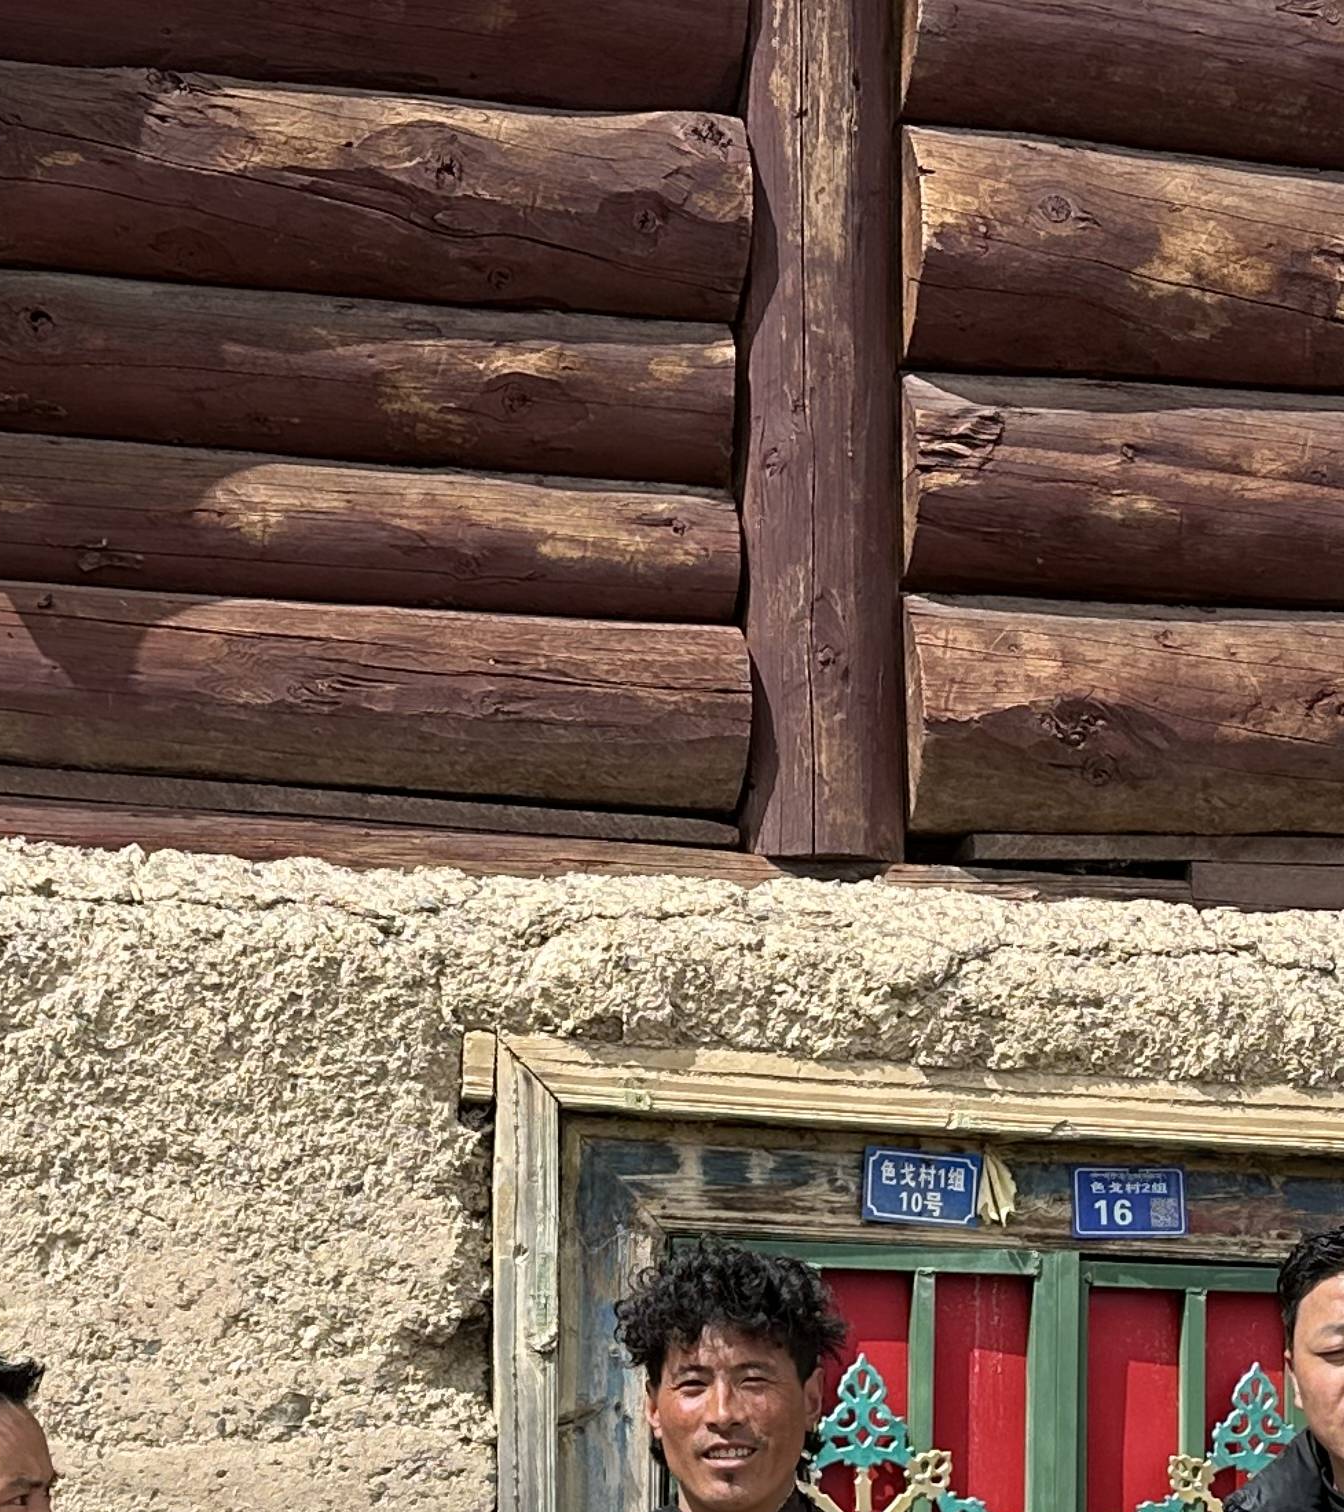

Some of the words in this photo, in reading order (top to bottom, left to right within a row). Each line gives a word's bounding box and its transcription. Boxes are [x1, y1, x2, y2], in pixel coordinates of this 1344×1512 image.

[881, 1159, 965, 1192] 色戈村1组
[1089, 1181, 1167, 1194] 色戈村2组
[899, 1191, 943, 1216] 10号
[1093, 1199, 1133, 1225] 16
